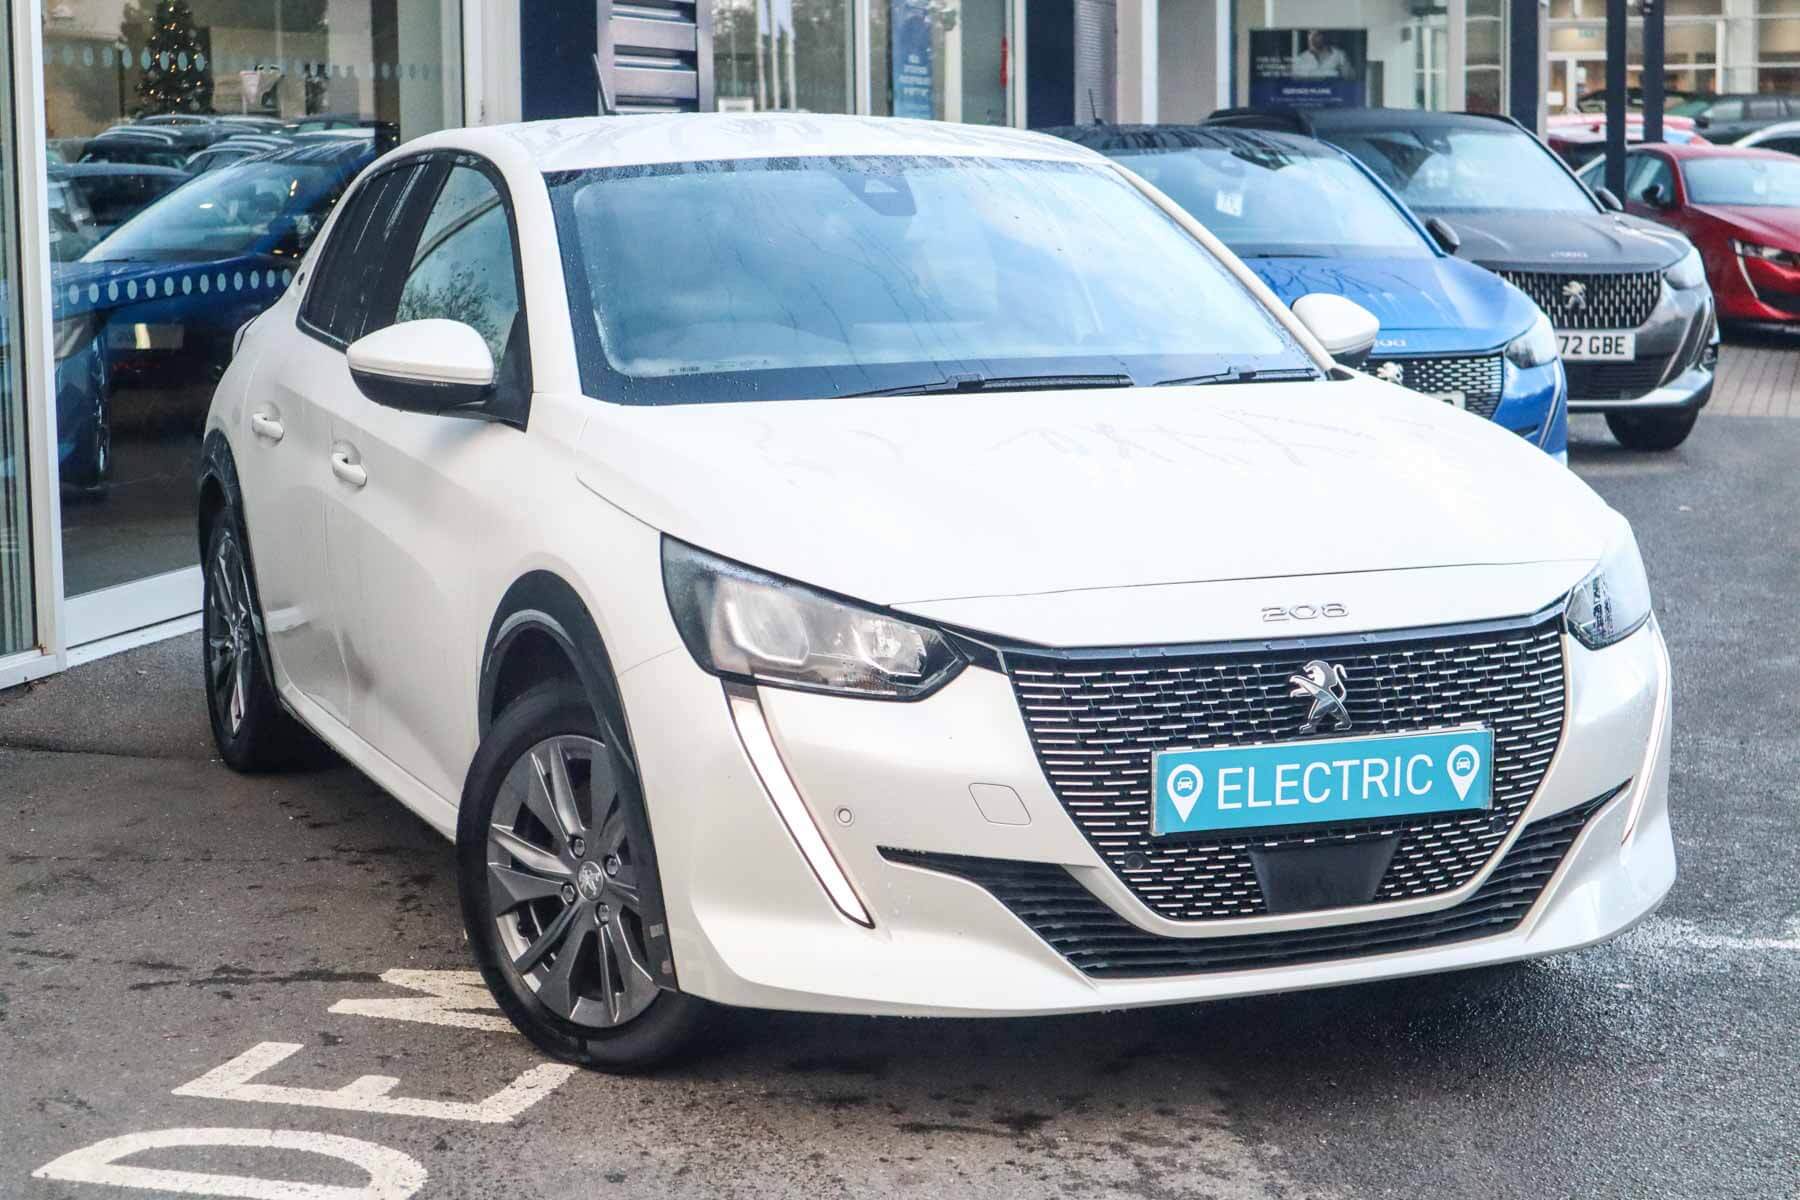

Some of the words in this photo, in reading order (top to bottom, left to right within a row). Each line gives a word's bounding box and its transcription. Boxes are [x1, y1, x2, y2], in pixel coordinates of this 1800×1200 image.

[1589, 335, 1625, 355] GBE
[1261, 602, 1350, 622] 208
[1217, 754, 1434, 810] ELECTRIC
[32, 968, 577, 1200] DEM
